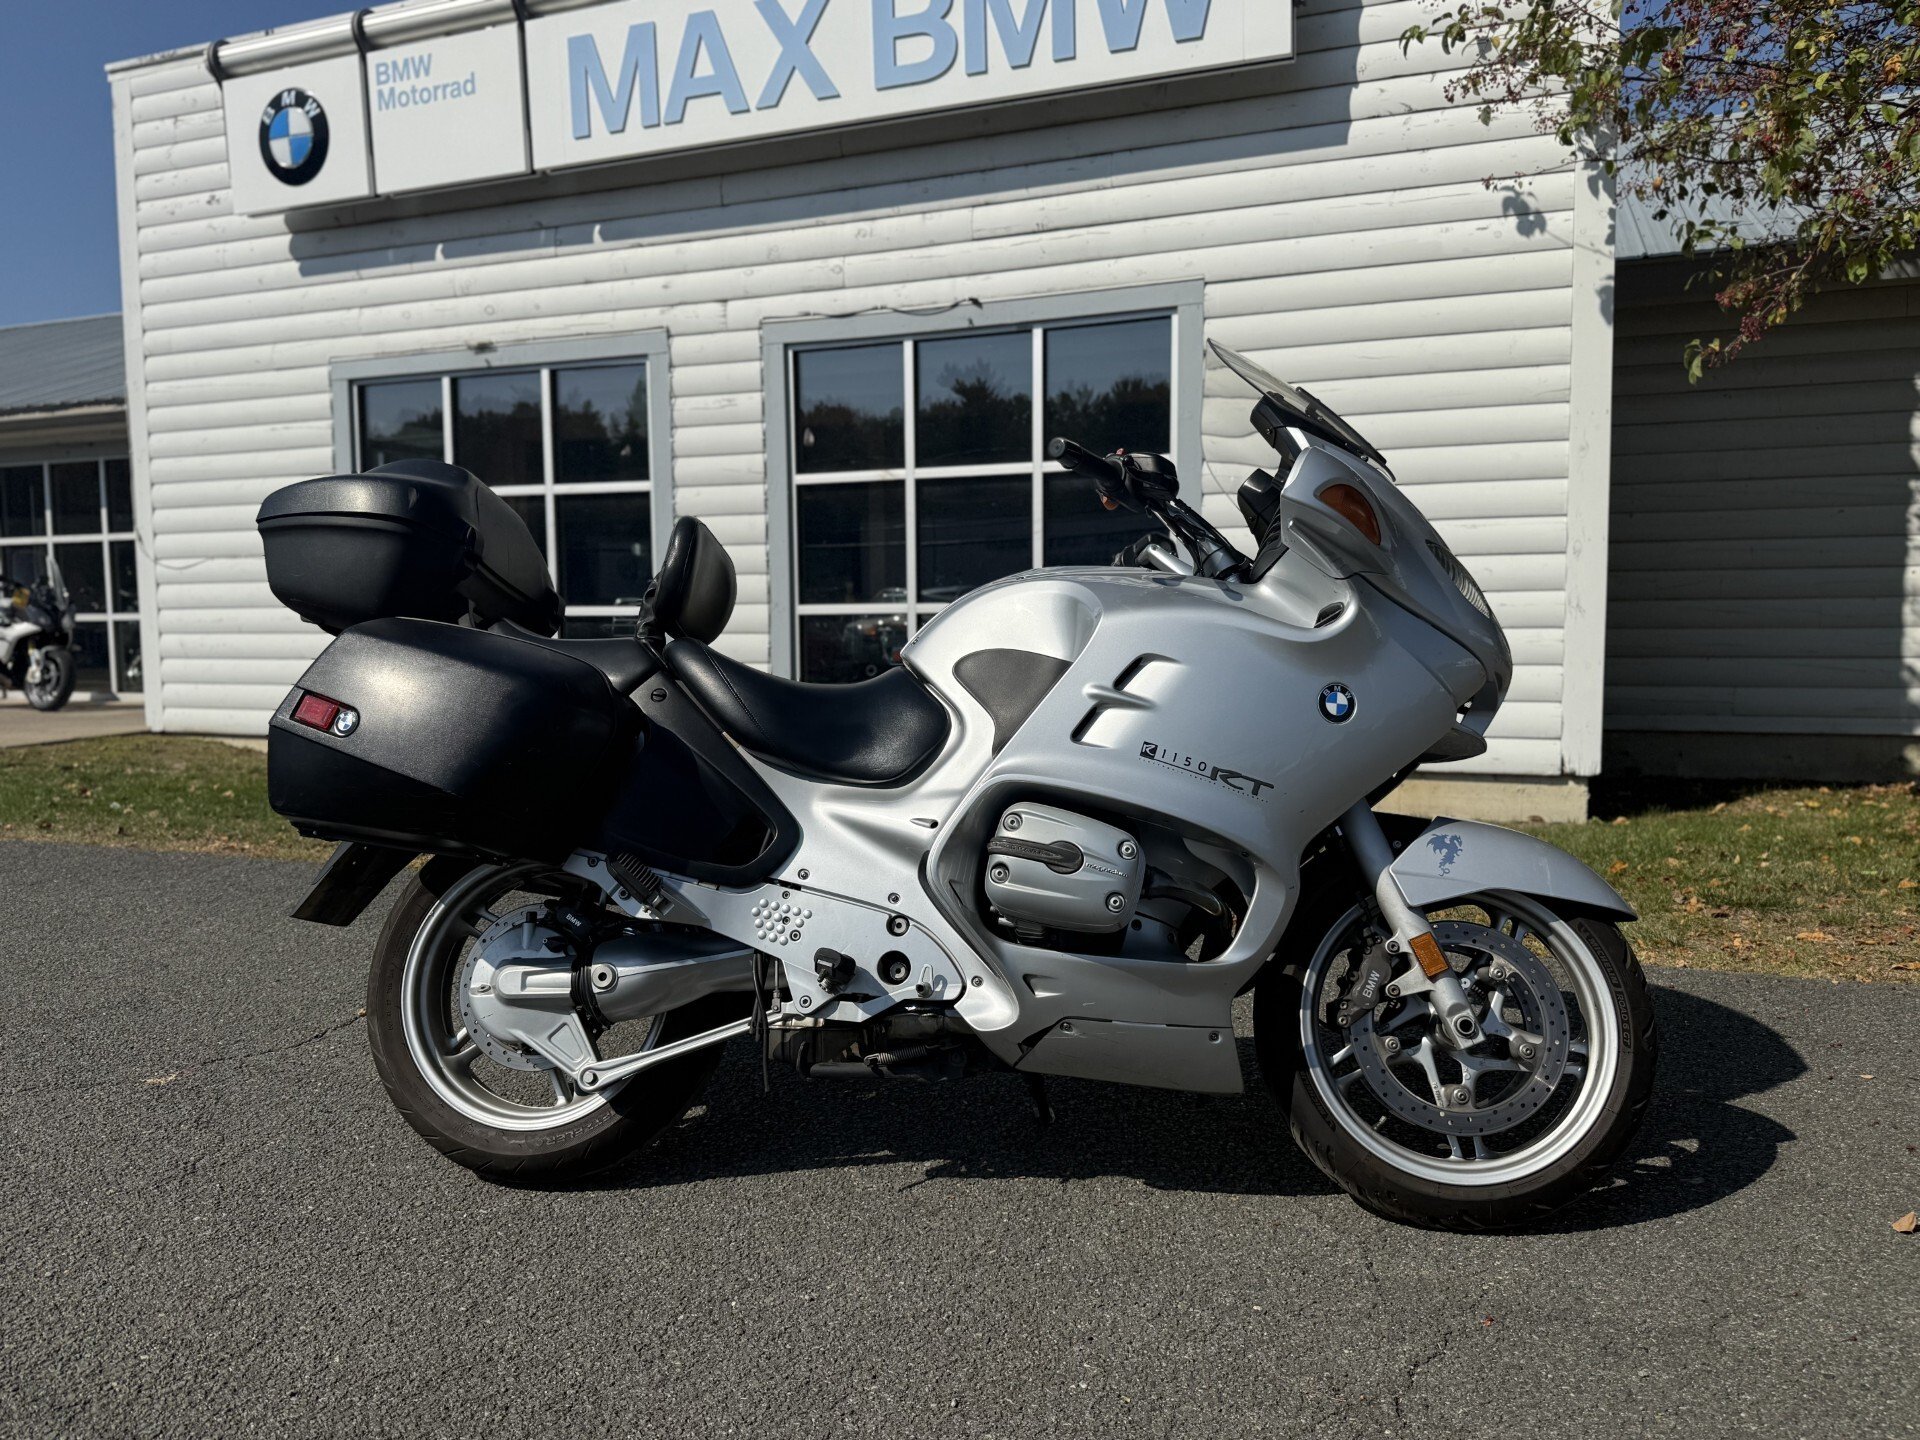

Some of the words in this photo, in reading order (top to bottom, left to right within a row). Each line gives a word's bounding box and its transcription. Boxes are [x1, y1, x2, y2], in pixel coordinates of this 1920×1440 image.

[374, 52, 433, 86] BMW
[567, 0, 842, 140] MAX
[261, 89, 322, 126] BMW
[376, 70, 477, 112] Motorrad
[564, 912, 583, 928] BMW
[1362, 969, 1380, 998] BMW
